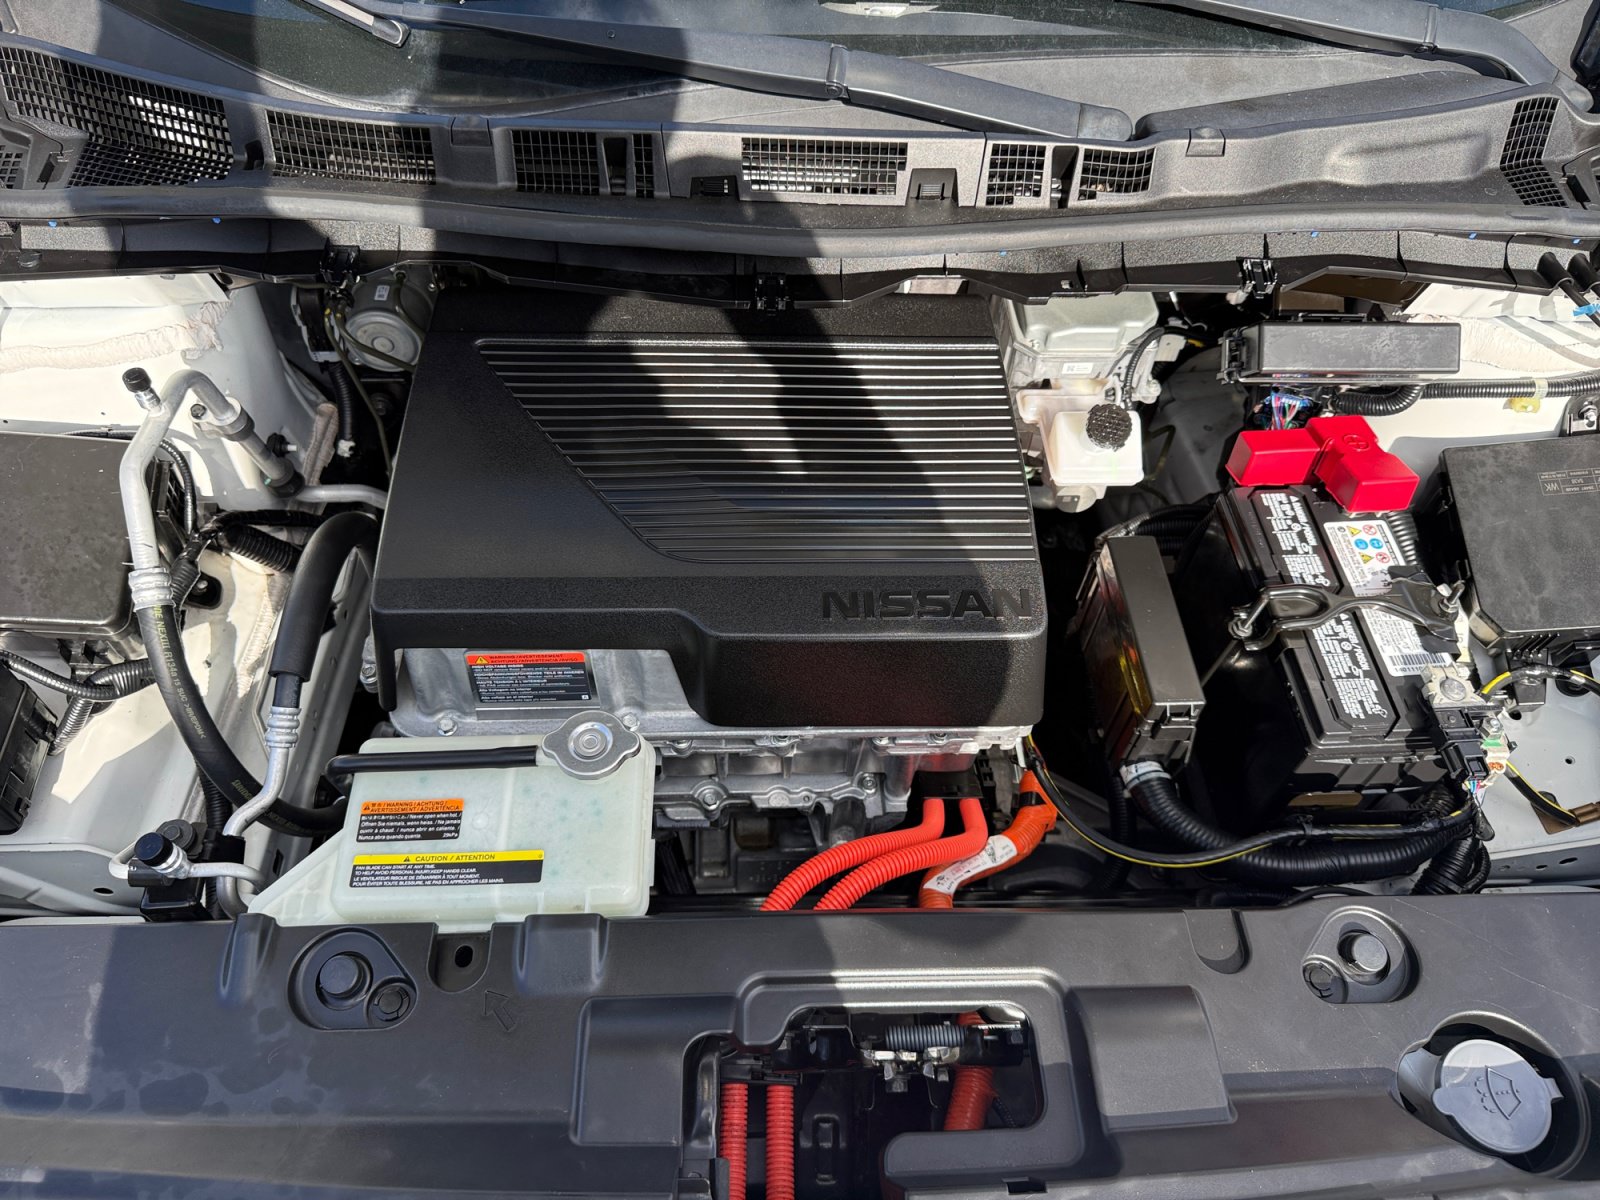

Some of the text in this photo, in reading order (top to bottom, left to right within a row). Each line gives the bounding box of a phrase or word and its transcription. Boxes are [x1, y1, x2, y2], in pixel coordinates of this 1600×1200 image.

[821, 588, 1032, 620] NISSAN
[163, 651, 178, 677] R134a
[177, 687, 188, 702] SUC
